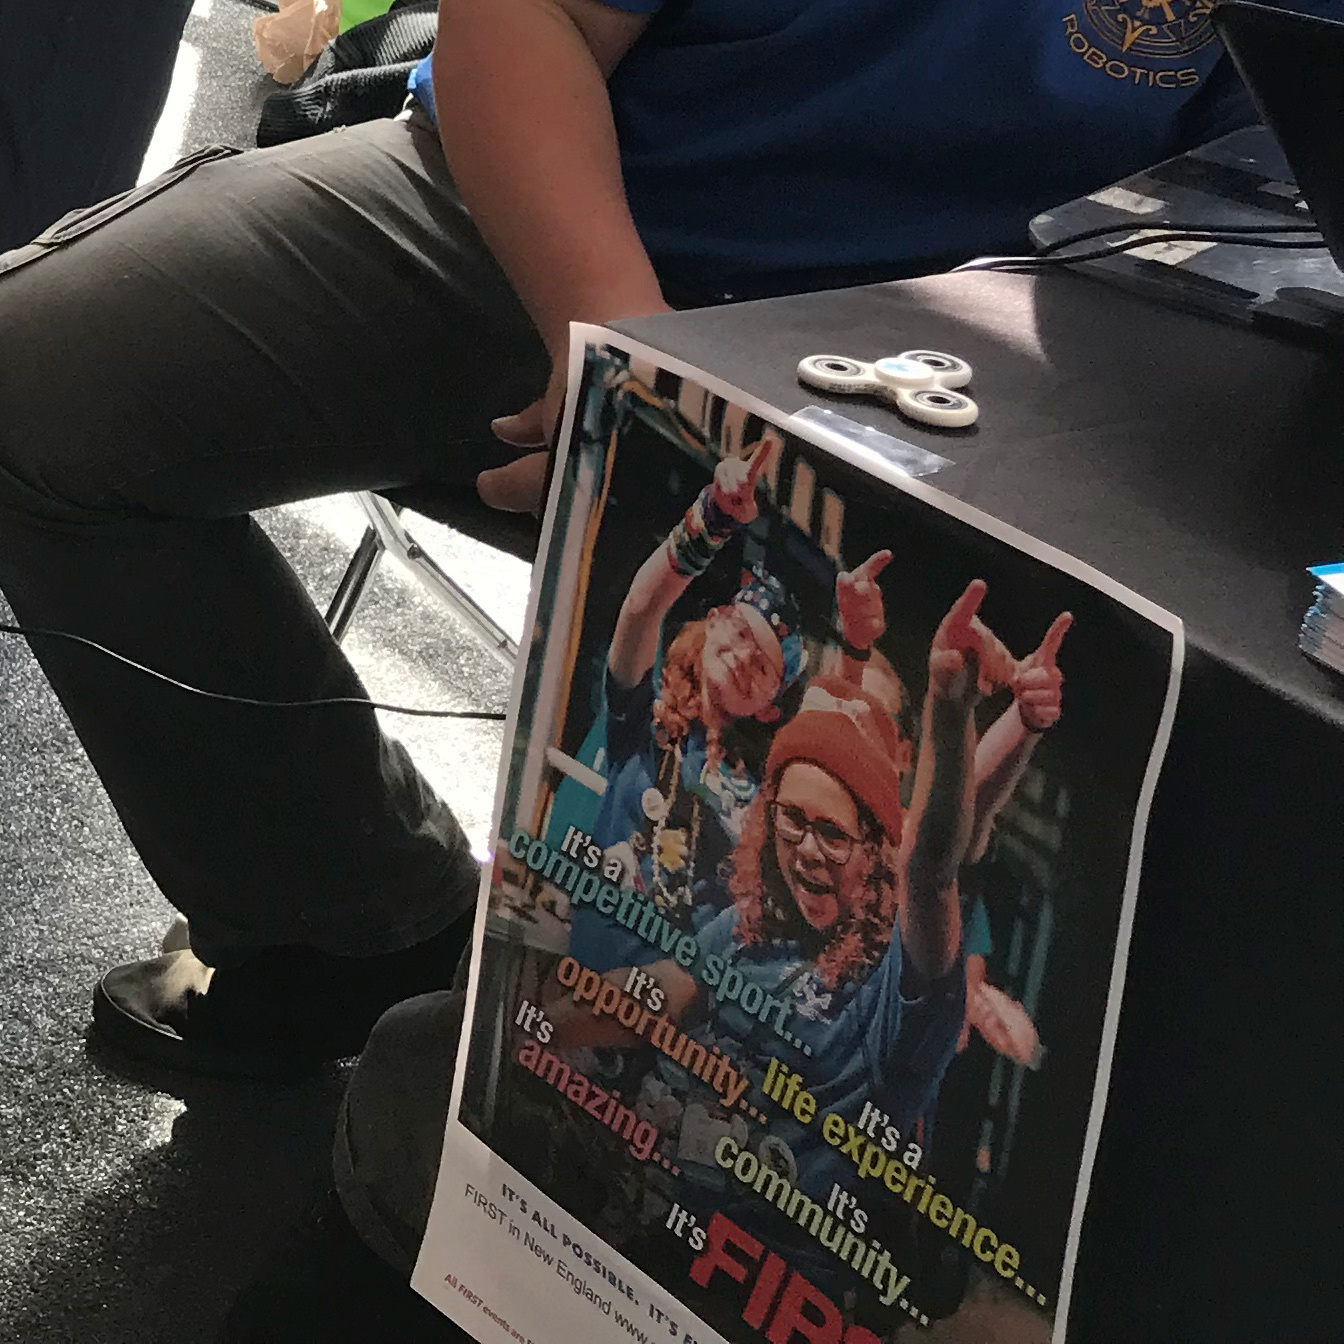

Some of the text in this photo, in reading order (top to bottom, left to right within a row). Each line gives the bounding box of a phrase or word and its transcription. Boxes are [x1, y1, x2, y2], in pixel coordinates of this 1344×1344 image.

[1063, 13, 1200, 88] ROBOTICS
[562, 825, 623, 882] It's a
[510, 830, 812, 1056] competitive sport...
[515, 1000, 555, 1044] It's
[624, 966, 665, 1012] It's
[556, 956, 767, 1125] opportunity...
[518, 1039, 682, 1176] amazing...
[857, 1101, 923, 1171] It's a
[761, 1057, 1047, 1307] life experience...
[827, 1183, 870, 1234] It's
[464, 1183, 508, 1227] FIRST
[508, 1218, 521, 1241] in
[523, 1229, 555, 1267] New
[555, 1258, 613, 1317] England
[502, 1183, 679, 1337] IT'S ALL POSSIBLE. IT'S
[665, 1202, 708, 1251] It's
[714, 1136, 930, 1328] community...
[458, 1283, 484, 1308] FIRST
